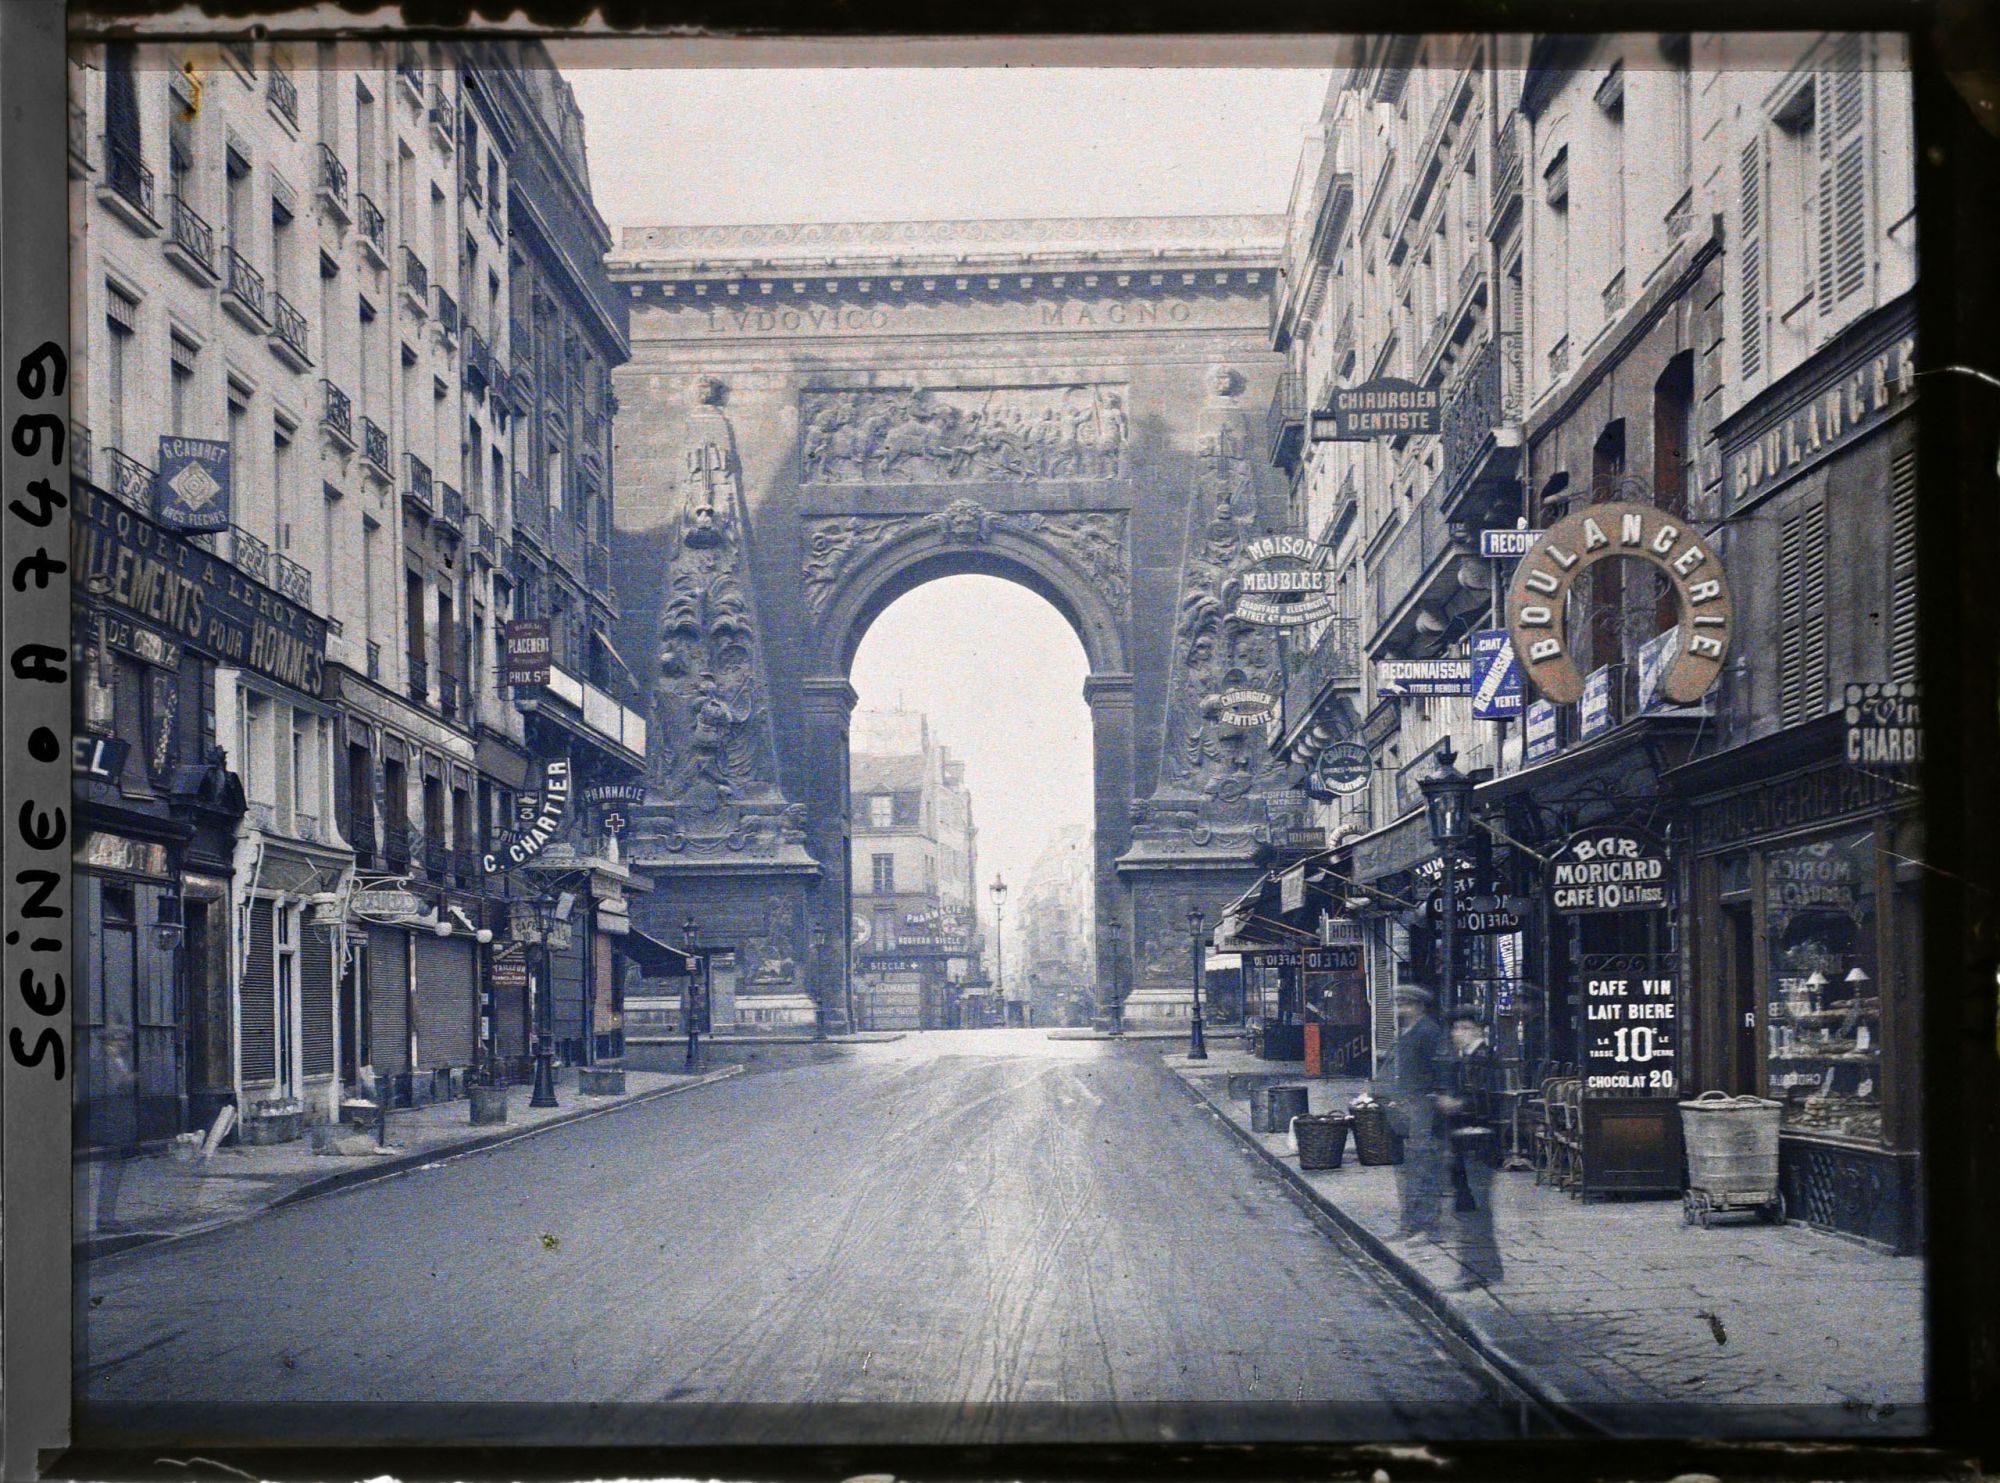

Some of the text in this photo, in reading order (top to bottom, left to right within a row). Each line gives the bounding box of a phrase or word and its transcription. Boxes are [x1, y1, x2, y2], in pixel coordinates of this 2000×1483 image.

[707, 302, 1192, 333] LVDOVICO MAGNO
[1338, 391, 1437, 409] CHIRURGIEN
[1347, 412, 1430, 430] DENTISTE
[9, 341, 67, 592] 7499
[1247, 536, 1318, 561] MAISON
[1520, 513, 1726, 665] BOULANGERIE
[227, 574, 298, 630] LEROY
[508, 637, 549, 654] PLACEMENT
[11, 644, 67, 684] A
[207, 617, 244, 658] POUR
[250, 616, 325, 696] HOMMES
[509, 671, 531, 683] PRIX
[1220, 690, 1272, 707] CHIRURGIEN
[1494, 695, 1521, 708] VENTE
[1222, 710, 1272, 726] DENTISTE
[584, 786, 645, 802] PHARMACIE
[509, 762, 568, 863] CHARTIER
[1572, 837, 1639, 861] BAR
[1554, 859, 1662, 886] MORICARD
[1598, 884, 1621, 908] 10
[906, 906, 962, 923] PHARMACIE
[1588, 980, 1672, 996] CAFE VIN
[1587, 1004, 1675, 1020] LAIT BIERE
[1597, 1038, 1610, 1046] LA
[1658, 1036, 1670, 1044] LE
[1589, 1049, 1675, 1058] TASSE VERRE
[1588, 1069, 1674, 1089] CHOCOLAT 20
